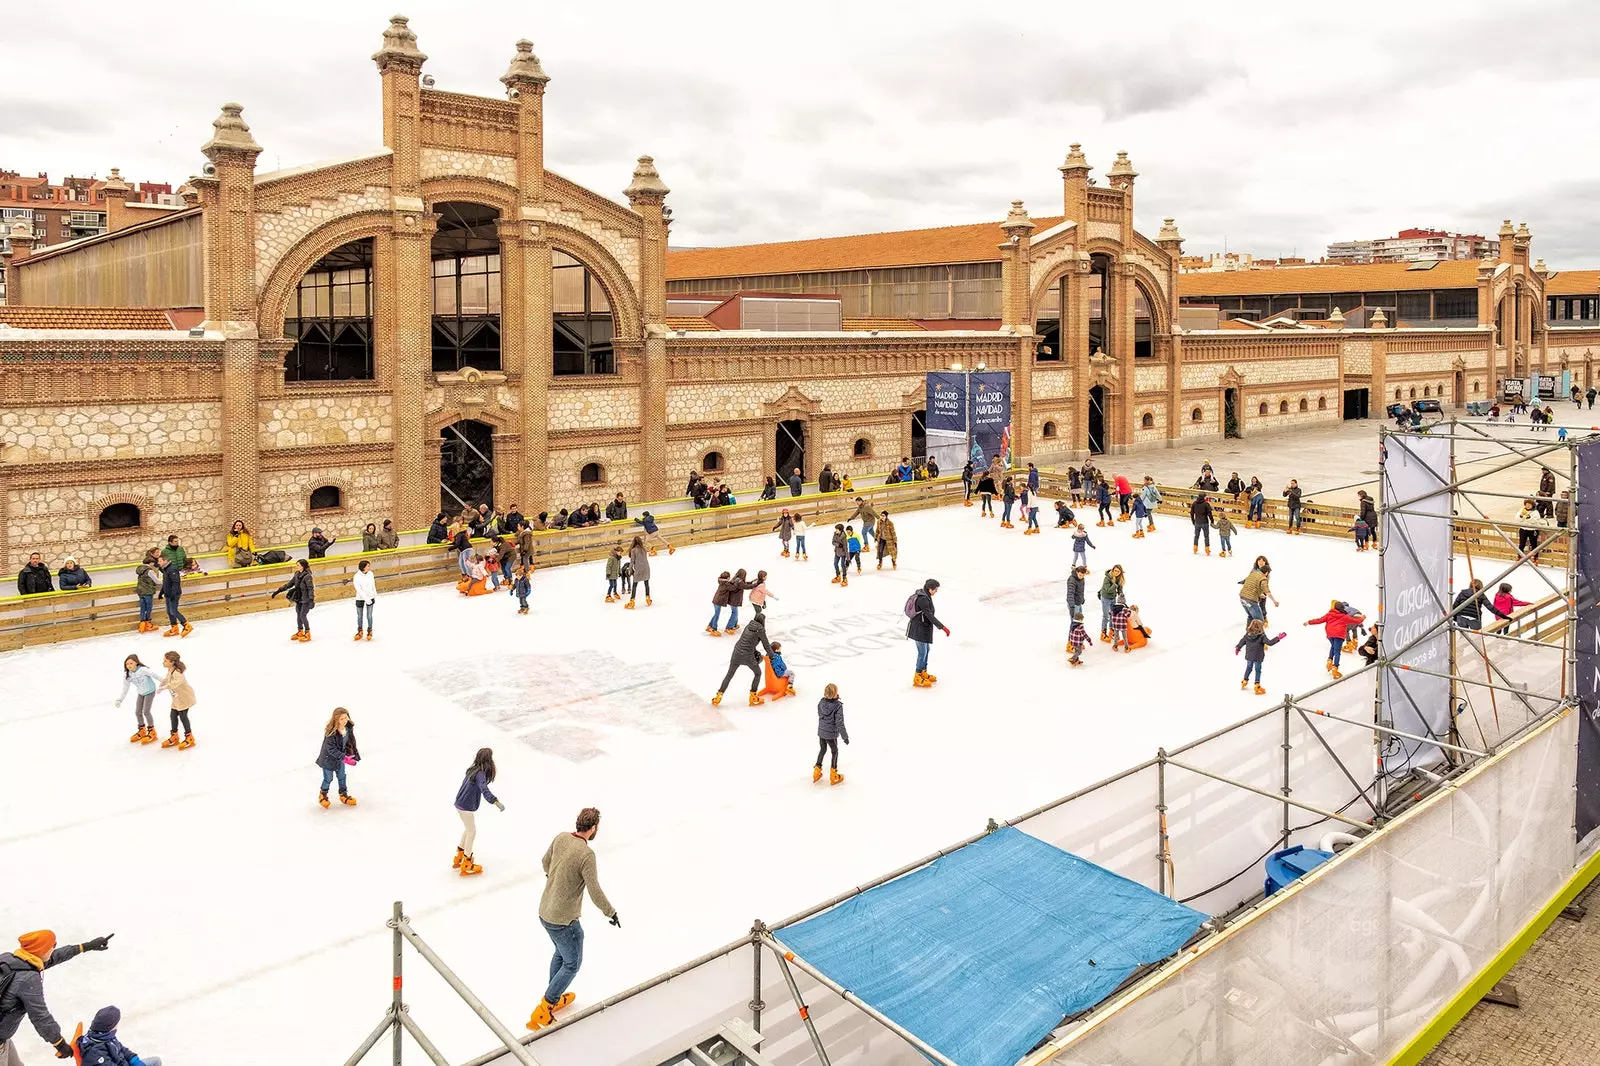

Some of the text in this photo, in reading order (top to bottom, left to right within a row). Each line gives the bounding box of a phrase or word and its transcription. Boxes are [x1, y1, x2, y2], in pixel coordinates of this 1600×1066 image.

[934, 391, 959, 400] MADRID
[976, 392, 1003, 402] MADRID
[934, 400, 959, 409] NAVIDAD
[976, 405, 1003, 415] NAVIDAD
